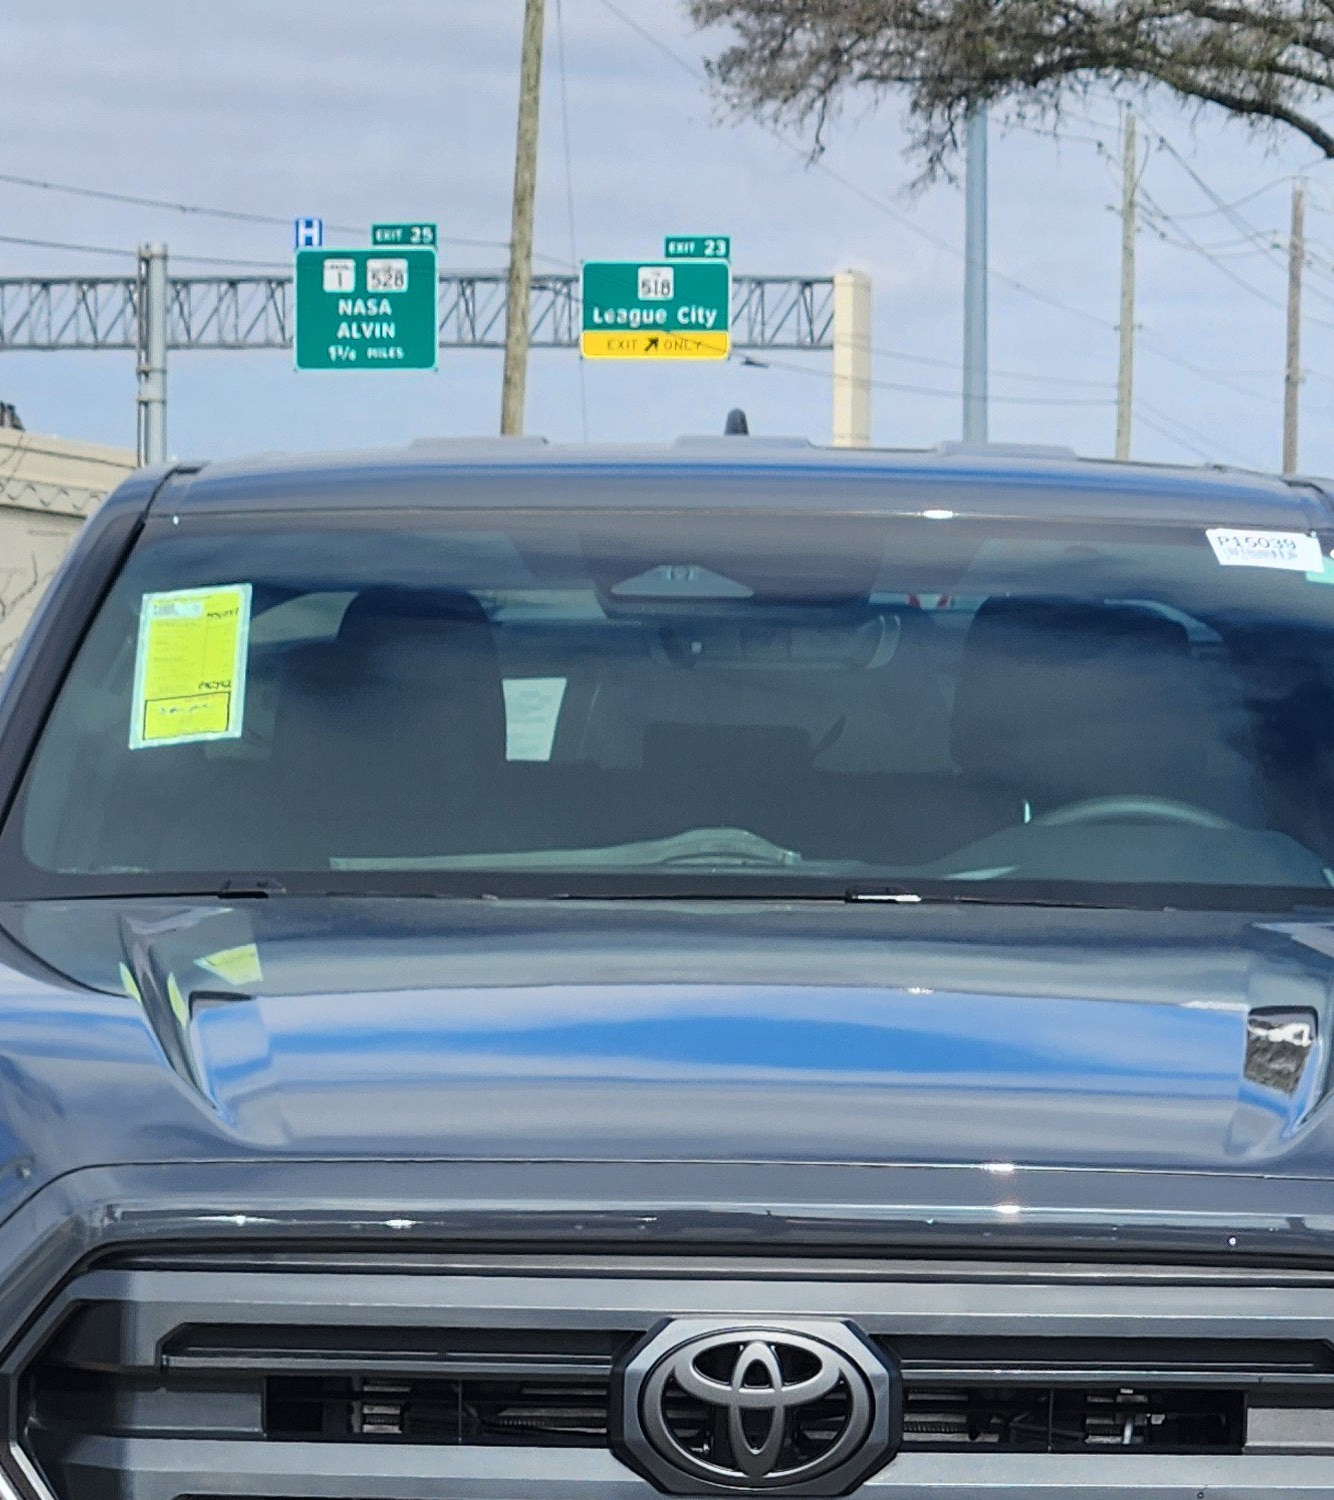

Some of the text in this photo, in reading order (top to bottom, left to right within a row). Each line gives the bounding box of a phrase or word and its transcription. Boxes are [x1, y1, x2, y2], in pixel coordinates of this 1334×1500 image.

[375, 227, 434, 244] EXIT 25
[668, 239, 726, 257] EXIT 23
[371, 270, 405, 288] 528
[641, 279, 671, 296] 518
[338, 298, 392, 316] NASA
[593, 304, 718, 329] League City
[336, 321, 395, 339] ALVIN
[367, 346, 405, 359] MILES
[606, 339, 702, 351] EXIT ONLY
